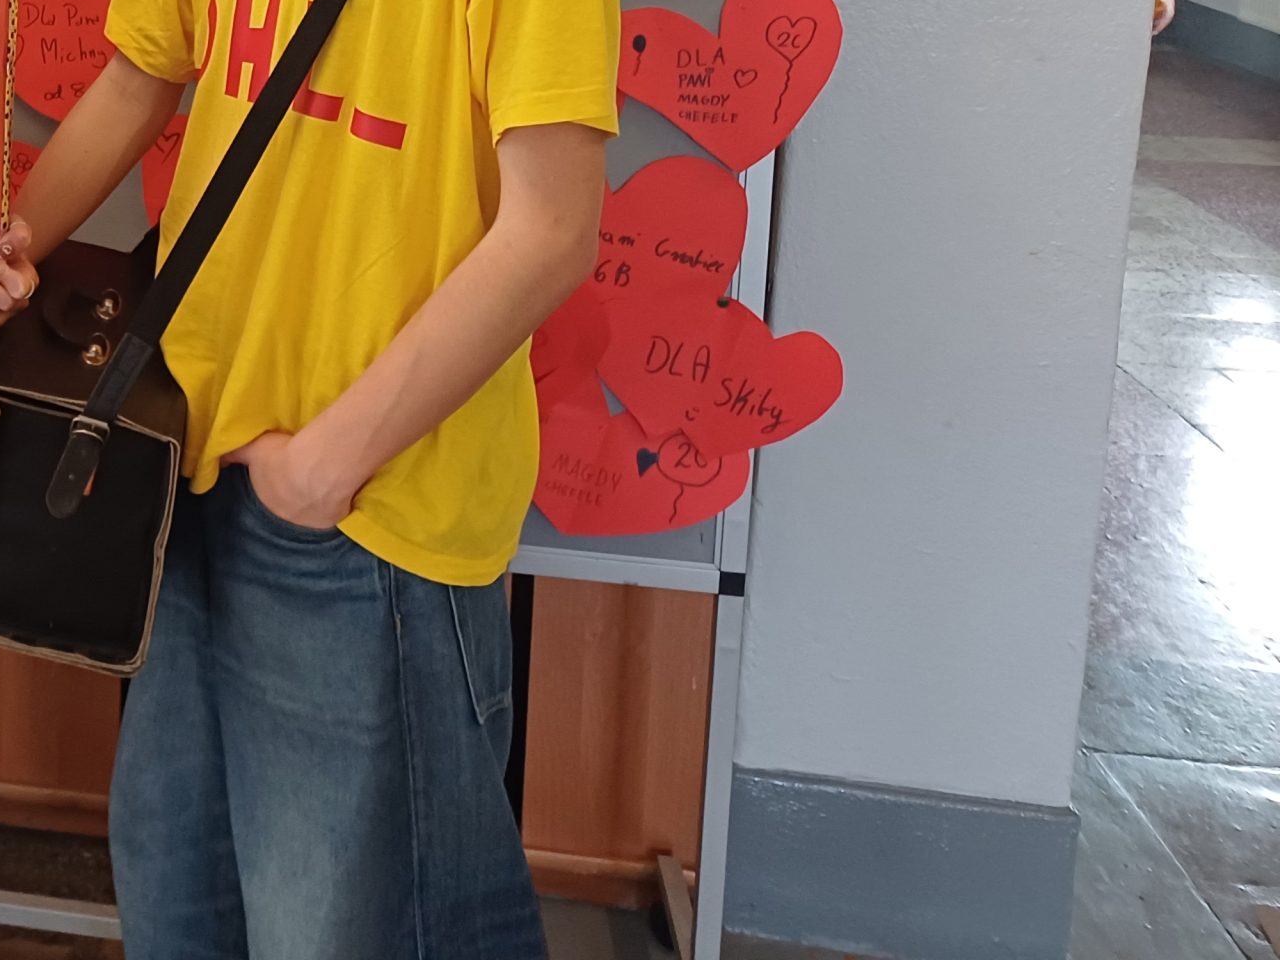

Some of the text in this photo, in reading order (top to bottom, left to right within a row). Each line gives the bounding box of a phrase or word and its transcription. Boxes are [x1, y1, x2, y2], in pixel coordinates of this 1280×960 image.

[676, 47, 727, 69] DLA
[677, 93, 731, 108] MAGDY
[645, 335, 711, 384] DLA
